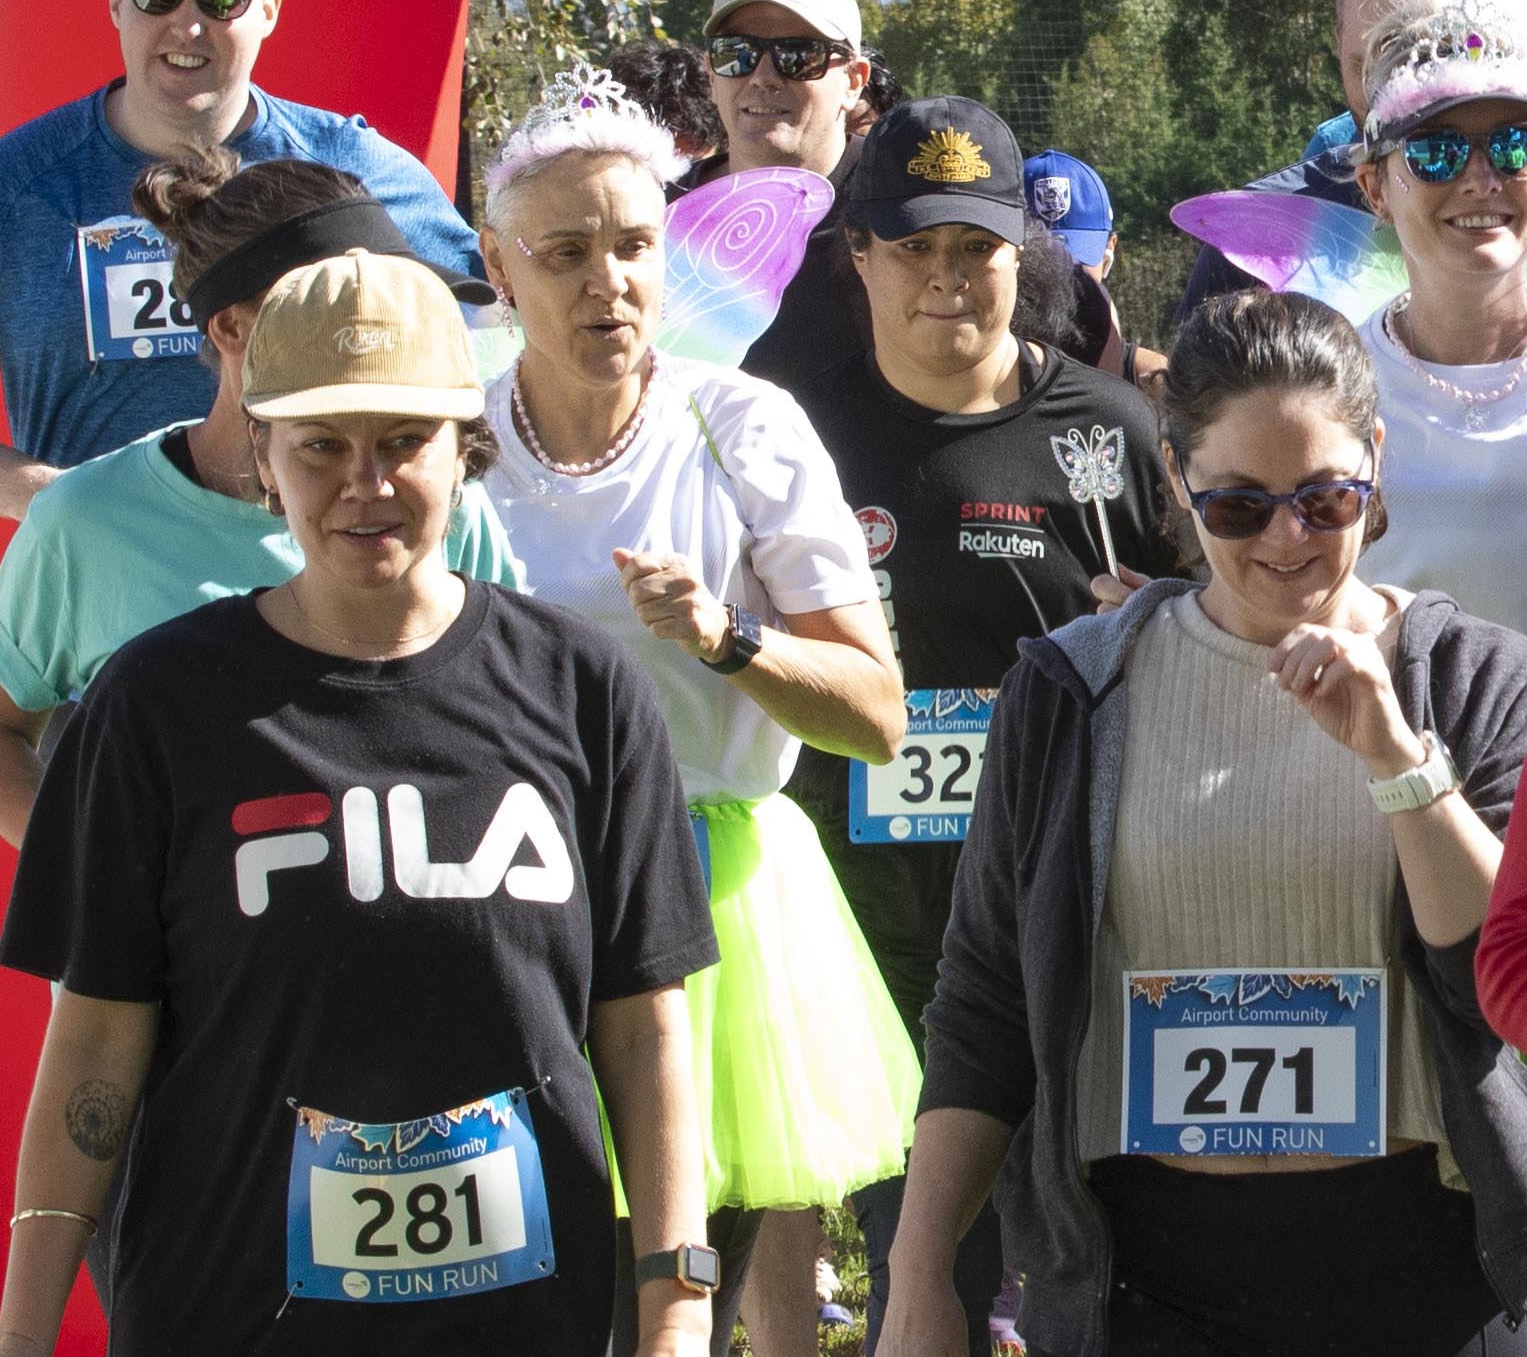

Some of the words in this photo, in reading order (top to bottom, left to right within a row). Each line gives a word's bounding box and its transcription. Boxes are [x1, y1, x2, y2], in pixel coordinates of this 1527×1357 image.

[125, 248, 167, 263] Airport
[131, 279, 196, 330] 28
[158, 336, 197, 355] FUN
[960, 501, 1046, 525] SPRINT
[959, 530, 1045, 558] Rakuten
[907, 720, 933, 734] port
[936, 718, 990, 730] Commu
[900, 744, 984, 804] 32
[917, 817, 958, 836] FUN
[231, 782, 575, 917] FILA
[1180, 1007, 1234, 1026] Airport
[1239, 1006, 1328, 1025] Community
[1183, 1047, 1314, 1115] 271
[1213, 1128, 1263, 1149] FUN
[1272, 1128, 1323, 1149] RUN
[335, 1152, 394, 1173] Airport
[397, 1137, 488, 1169] Community
[351, 1173, 483, 1257] 281
[378, 1274, 433, 1296] FUN
[443, 1261, 499, 1291] RUN
